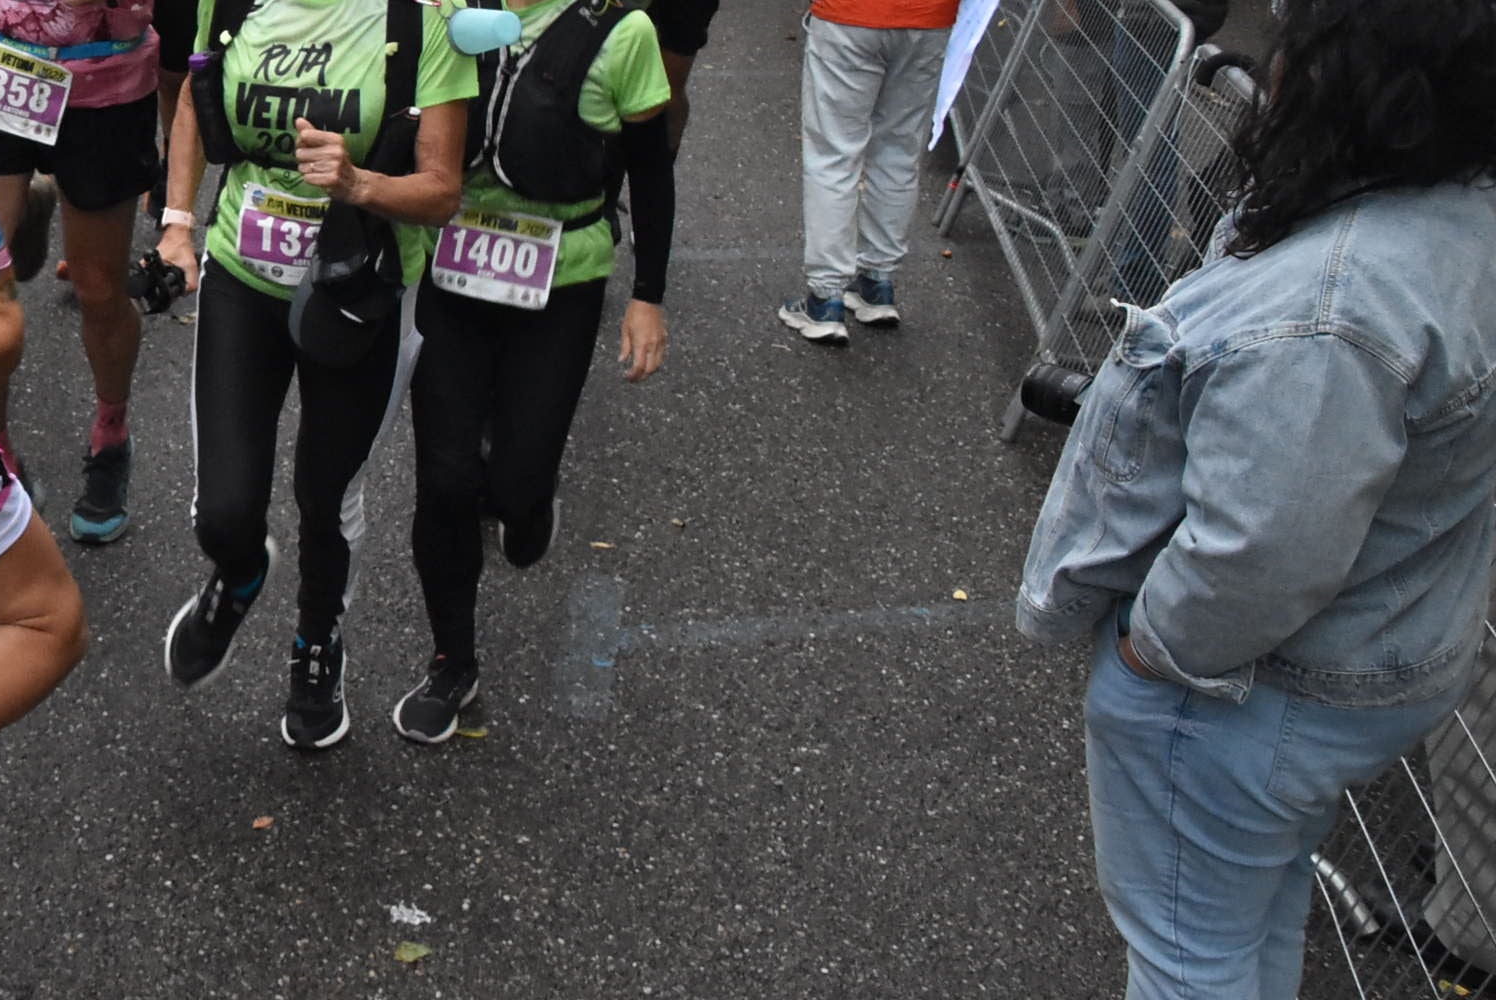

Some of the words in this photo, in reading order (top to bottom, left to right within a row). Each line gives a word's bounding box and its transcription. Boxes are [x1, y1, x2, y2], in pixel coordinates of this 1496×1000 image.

[253, 42, 333, 87] RUTA
[235, 82, 362, 134] VETONA
[256, 131, 296, 154] 20
[256, 215, 321, 258] 132
[453, 228, 539, 279] 1400
